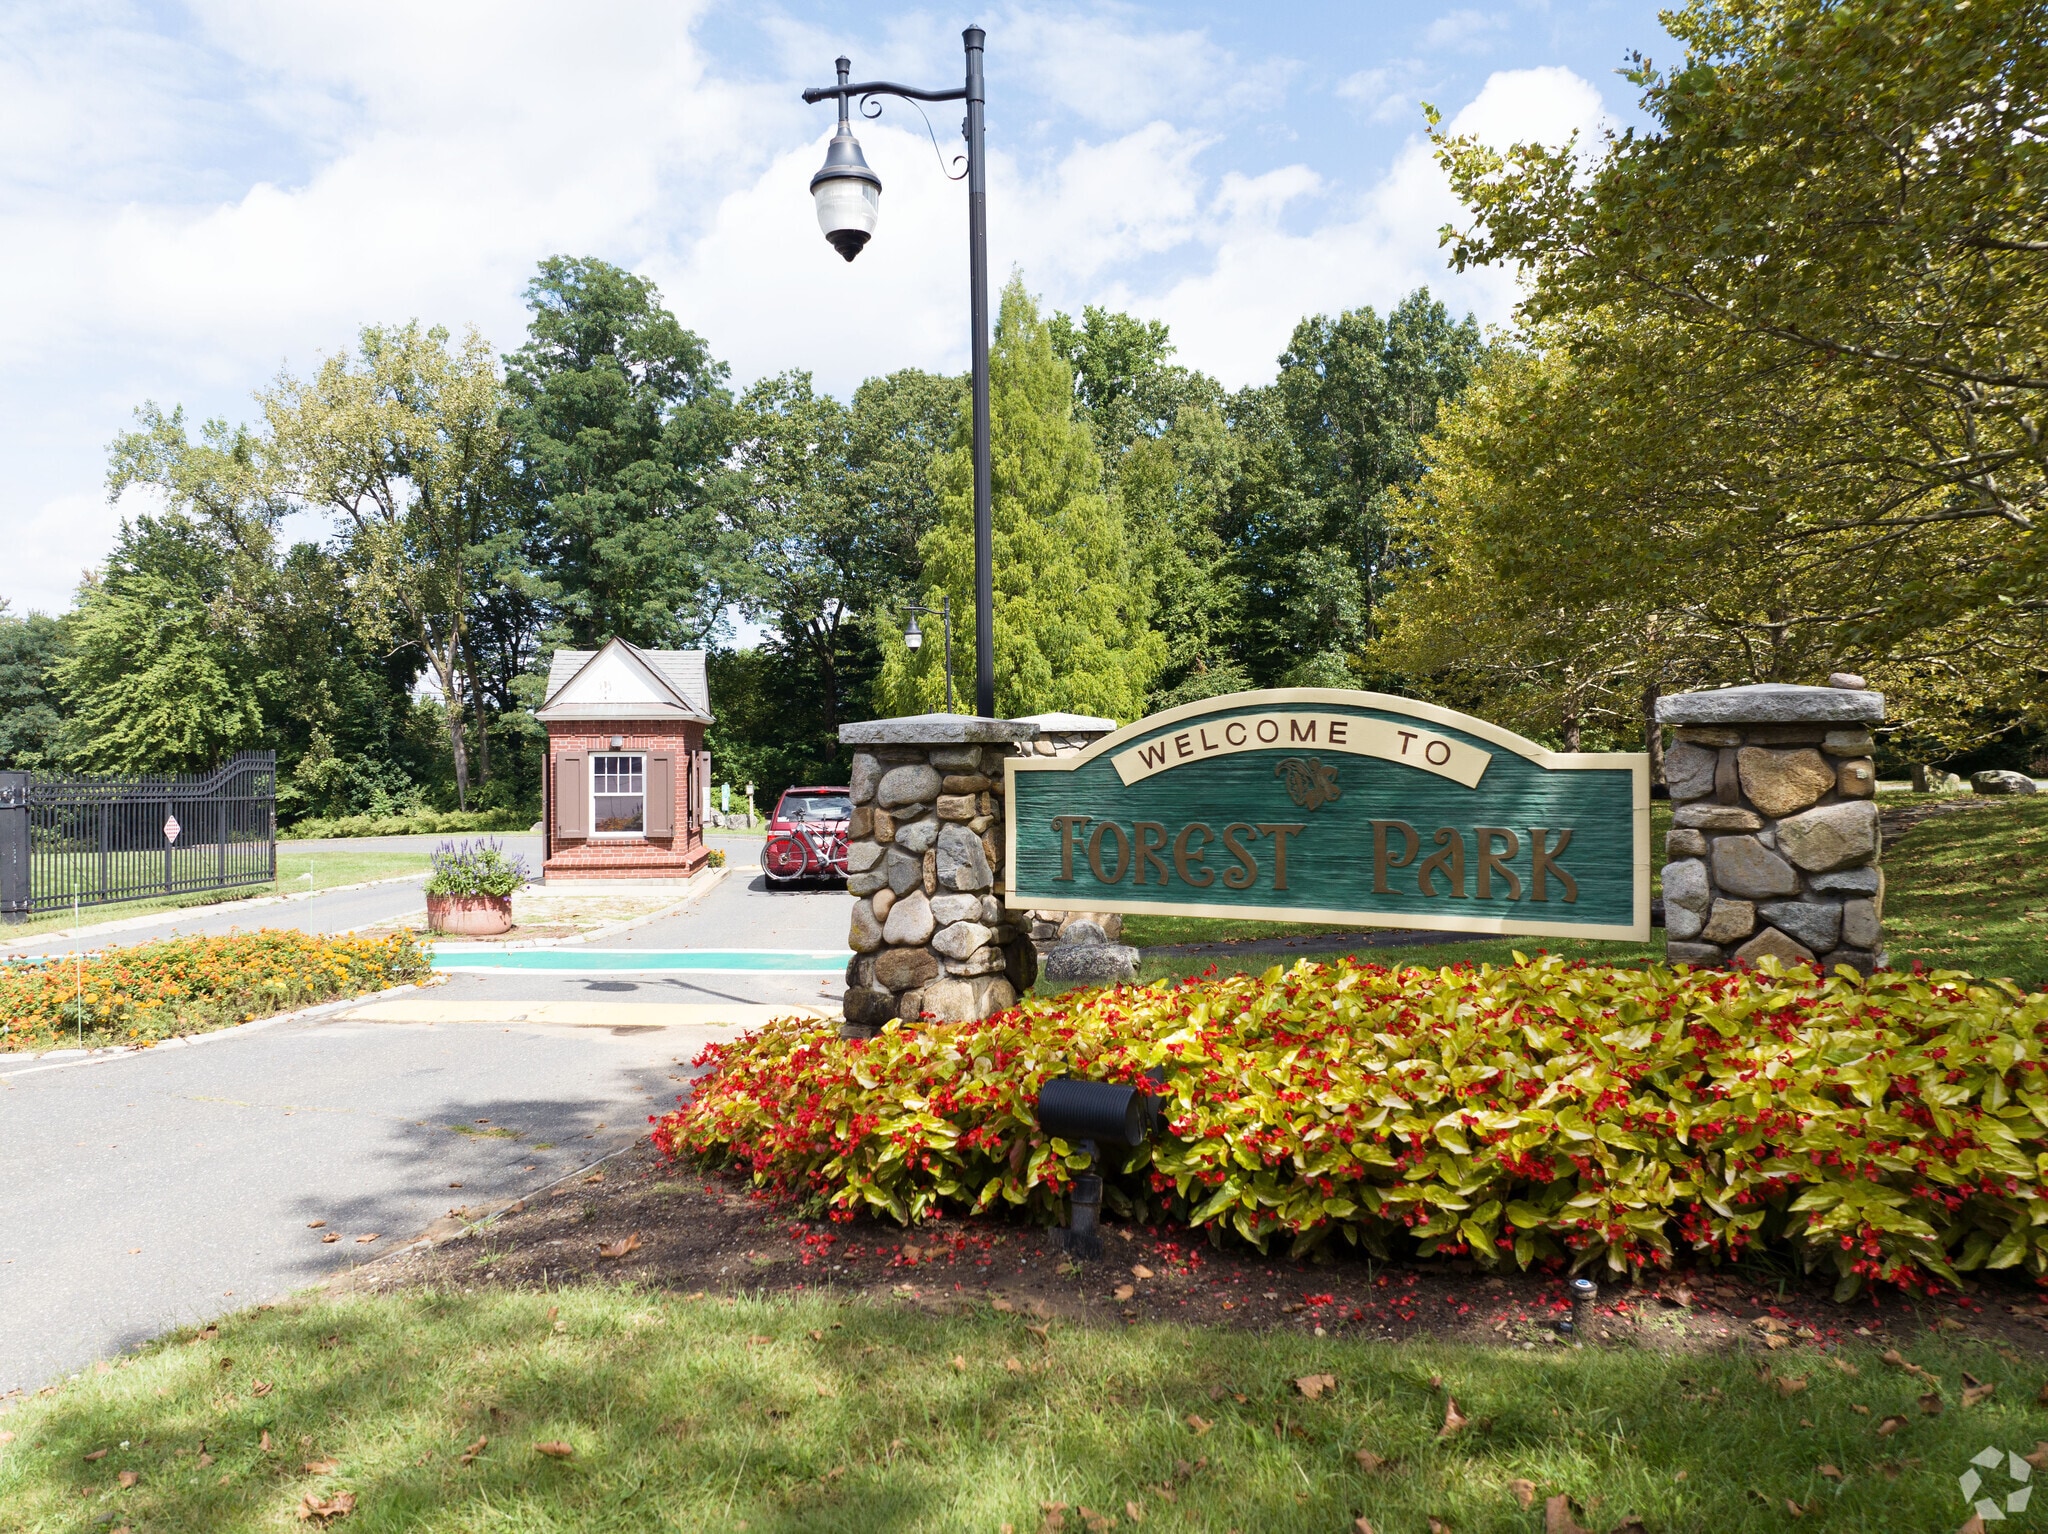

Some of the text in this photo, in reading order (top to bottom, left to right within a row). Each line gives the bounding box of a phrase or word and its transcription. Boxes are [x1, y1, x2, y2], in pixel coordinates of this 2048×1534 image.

[1138, 719, 1451, 769] WELCOME TO
[1051, 815, 1578, 903] FOREST PARK
